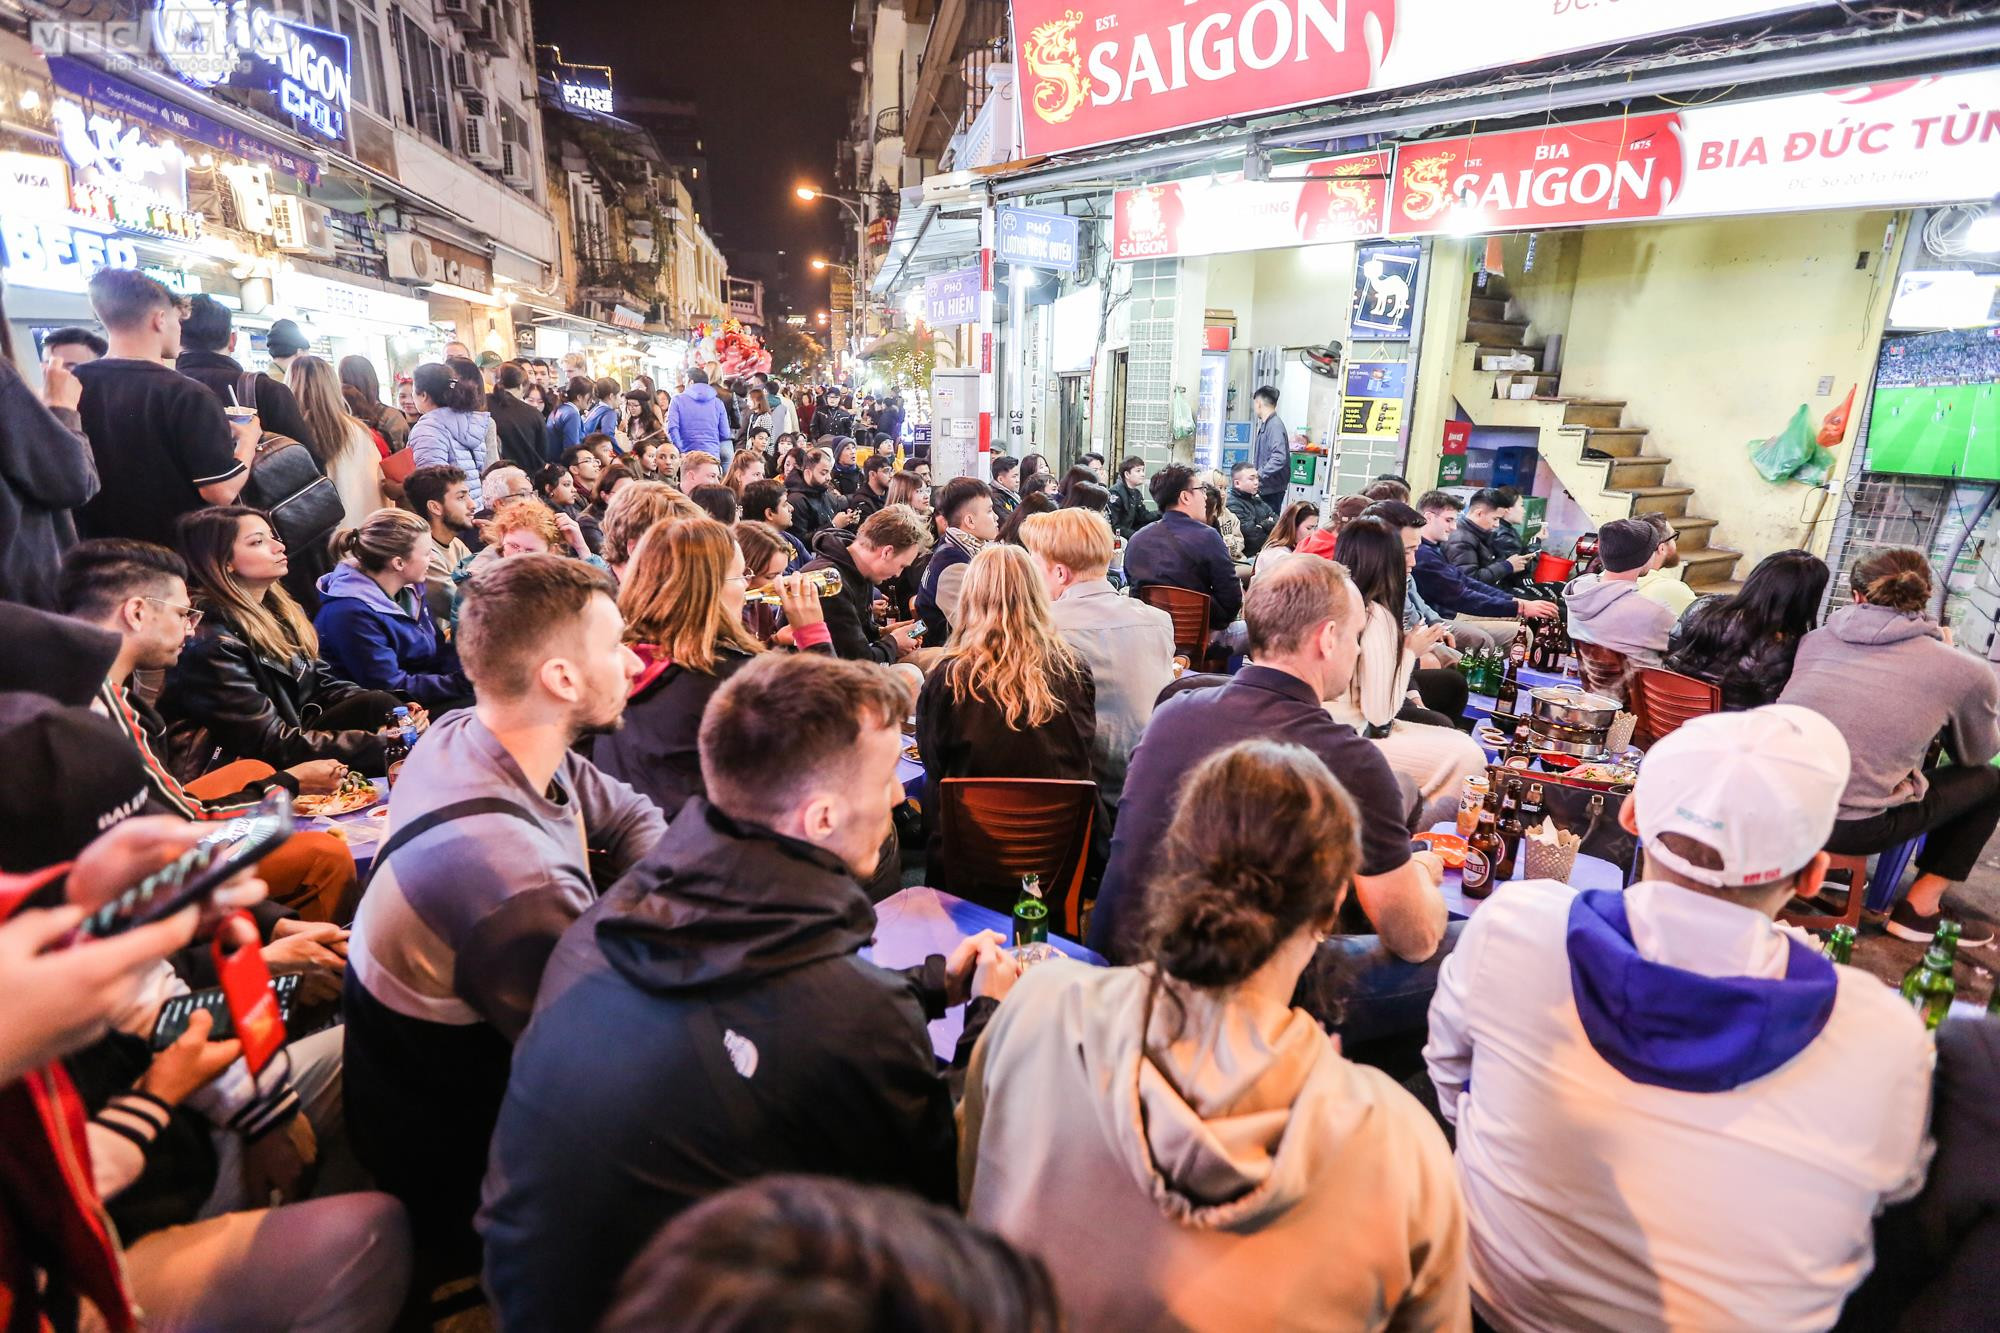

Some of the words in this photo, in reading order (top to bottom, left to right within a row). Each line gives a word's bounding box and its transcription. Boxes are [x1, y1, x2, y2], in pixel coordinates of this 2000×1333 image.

[1096, 14, 1119, 32] EST.
[252, 7, 351, 113] SAIGON
[1087, 0, 1348, 107] SAIGON
[170, 110, 190, 128] VISA
[1534, 143, 1570, 161] BIA
[1630, 139, 1652, 151] 1875
[1697, 136, 1768, 171] BIA
[1783, 117, 1896, 162] ĐỨC
[13, 172, 50, 189] VISA
[1452, 157, 1656, 212] SAIGON
[1026, 220, 1052, 235] PHỐ
[1119, 239, 1168, 256] SAIGON
[943, 280, 963, 294] PHỐ
[932, 300, 946, 322] TẠ
[949, 294, 974, 318] HIỆN
[1009, 410, 1023, 419] CG
